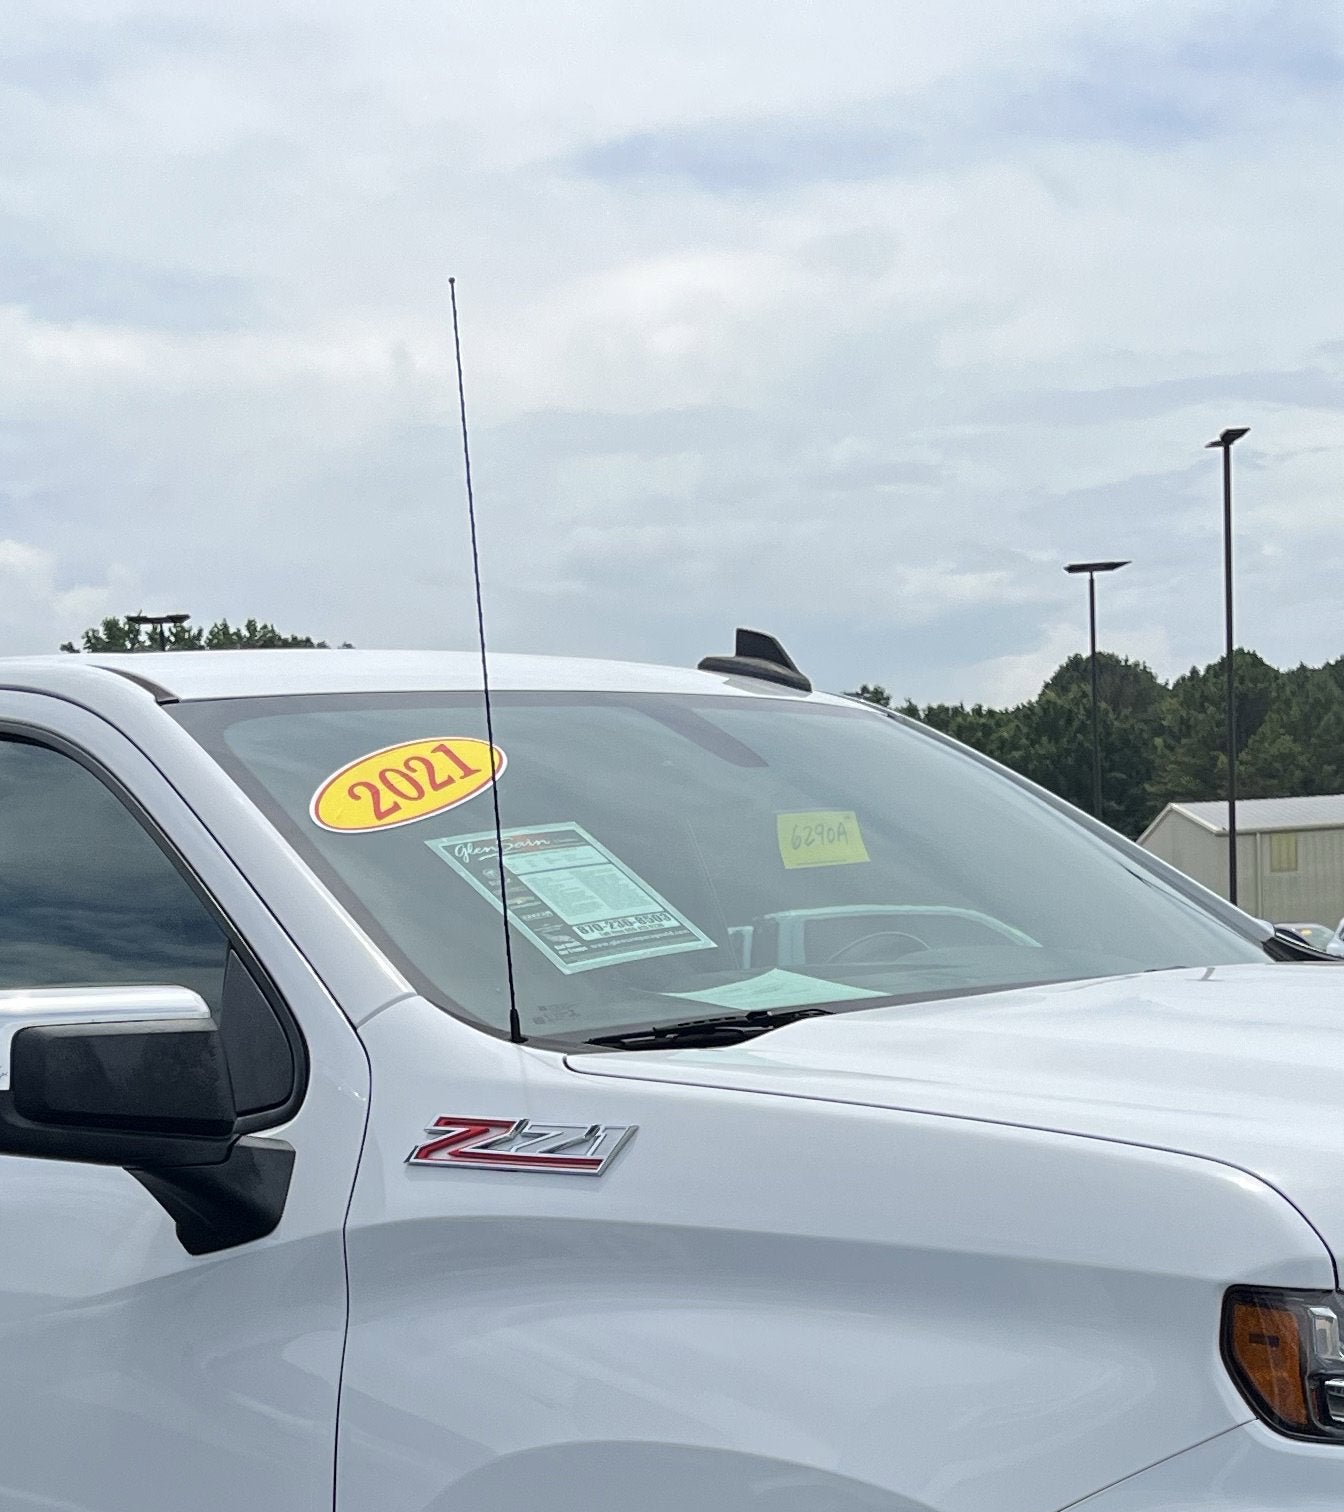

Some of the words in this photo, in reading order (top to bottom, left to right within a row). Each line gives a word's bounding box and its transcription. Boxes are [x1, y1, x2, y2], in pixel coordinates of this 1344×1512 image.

[347, 744, 482, 821] 2021
[454, 841, 497, 863] Glen
[790, 822, 849, 850] 6290A
[403, 1113, 639, 1178] Z71
